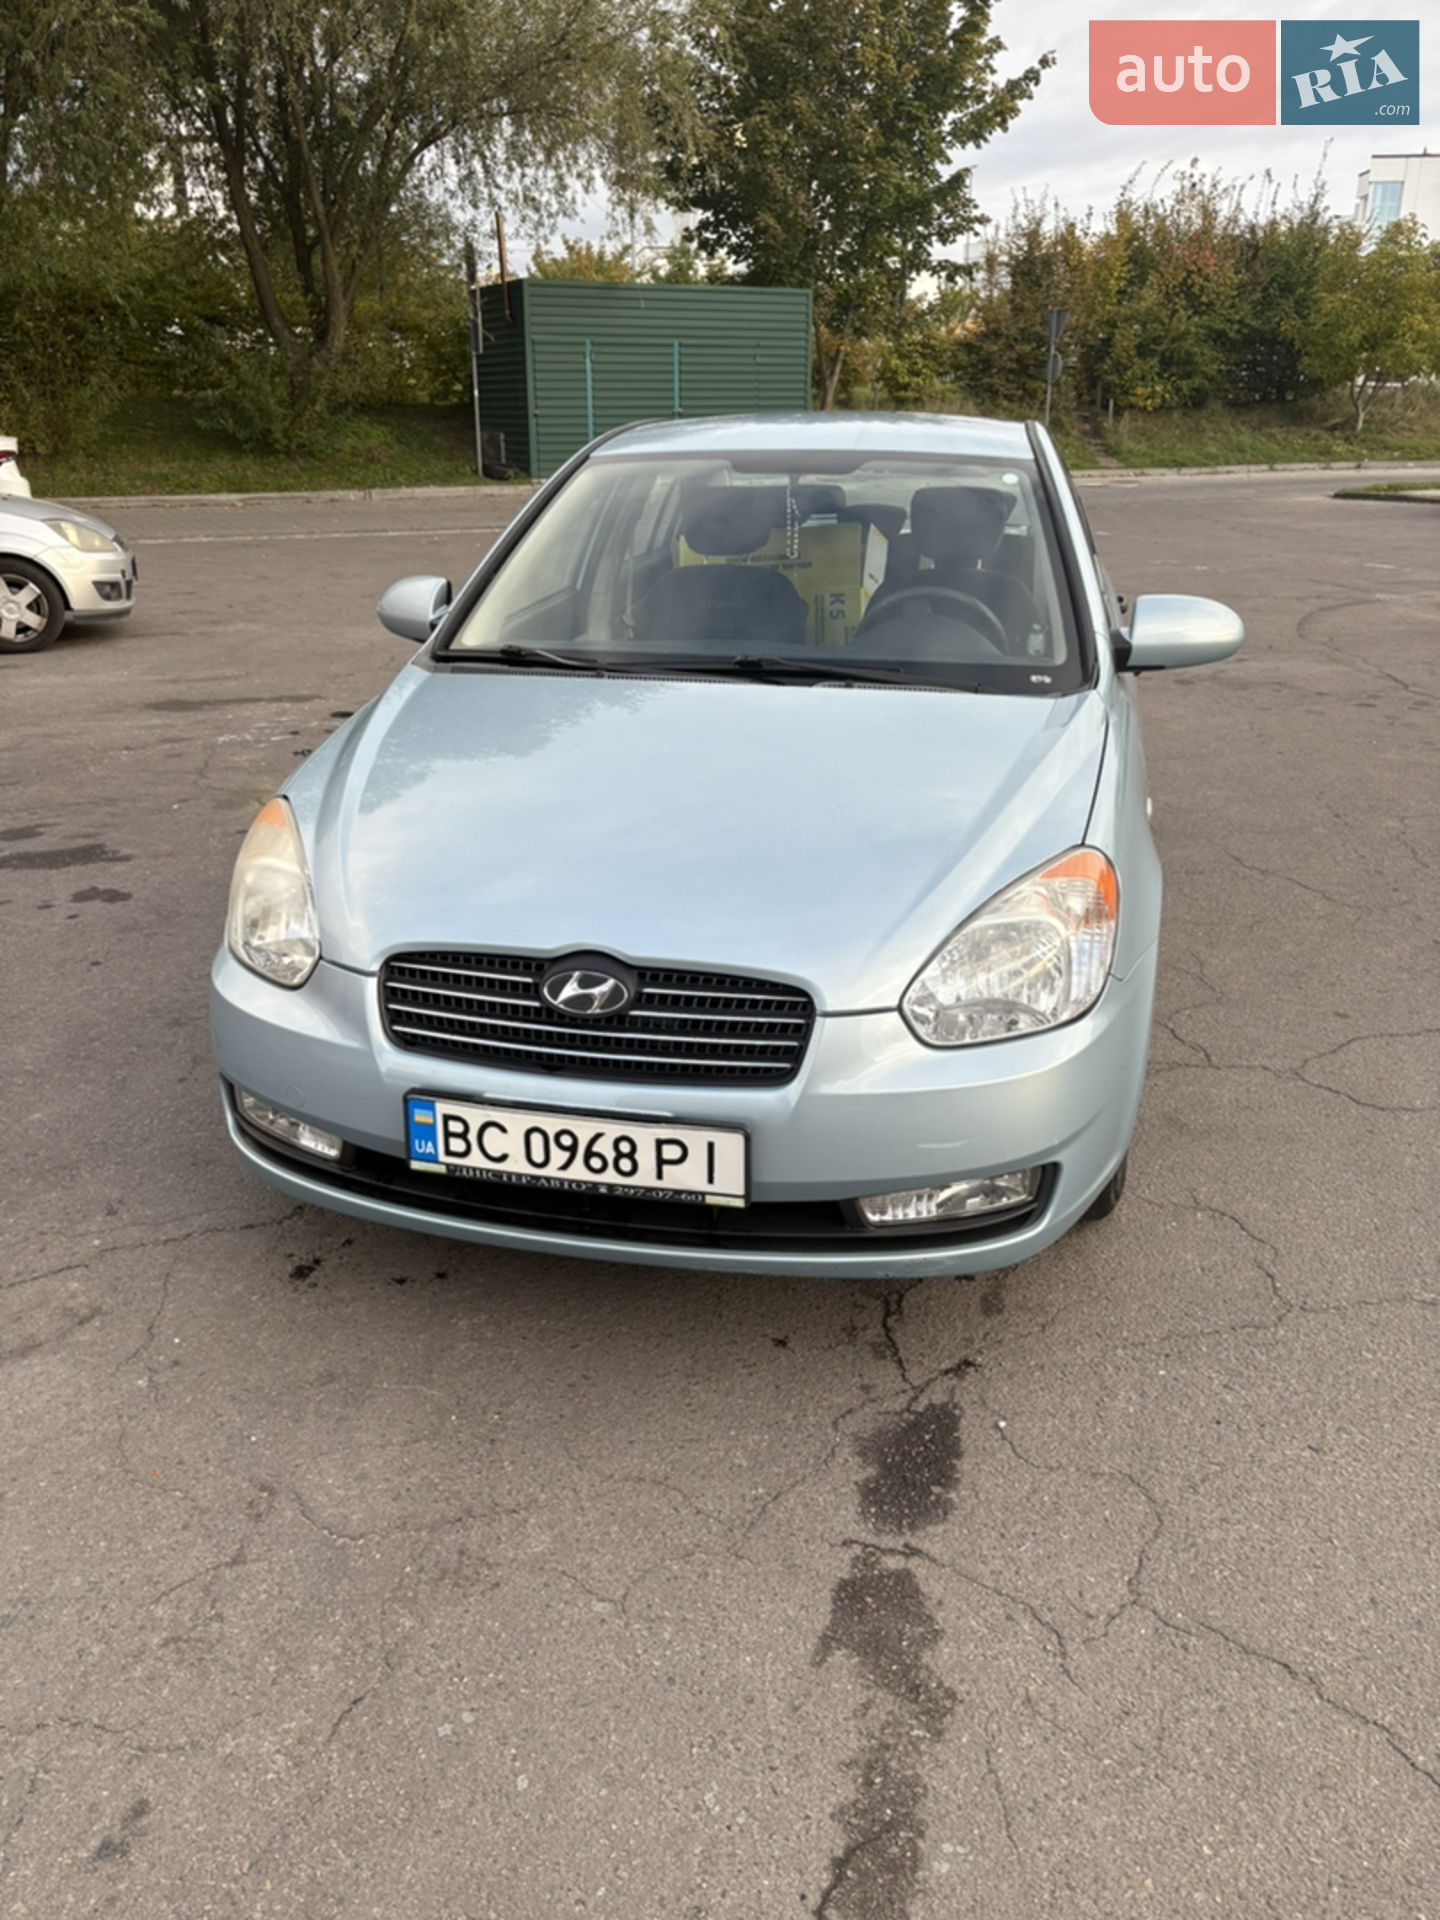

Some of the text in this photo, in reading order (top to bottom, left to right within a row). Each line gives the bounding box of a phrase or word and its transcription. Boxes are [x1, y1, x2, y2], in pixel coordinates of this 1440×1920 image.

[415, 1140, 436, 1156] UA
[442, 1112, 510, 1165] BC
[523, 1126, 639, 1178] 0968
